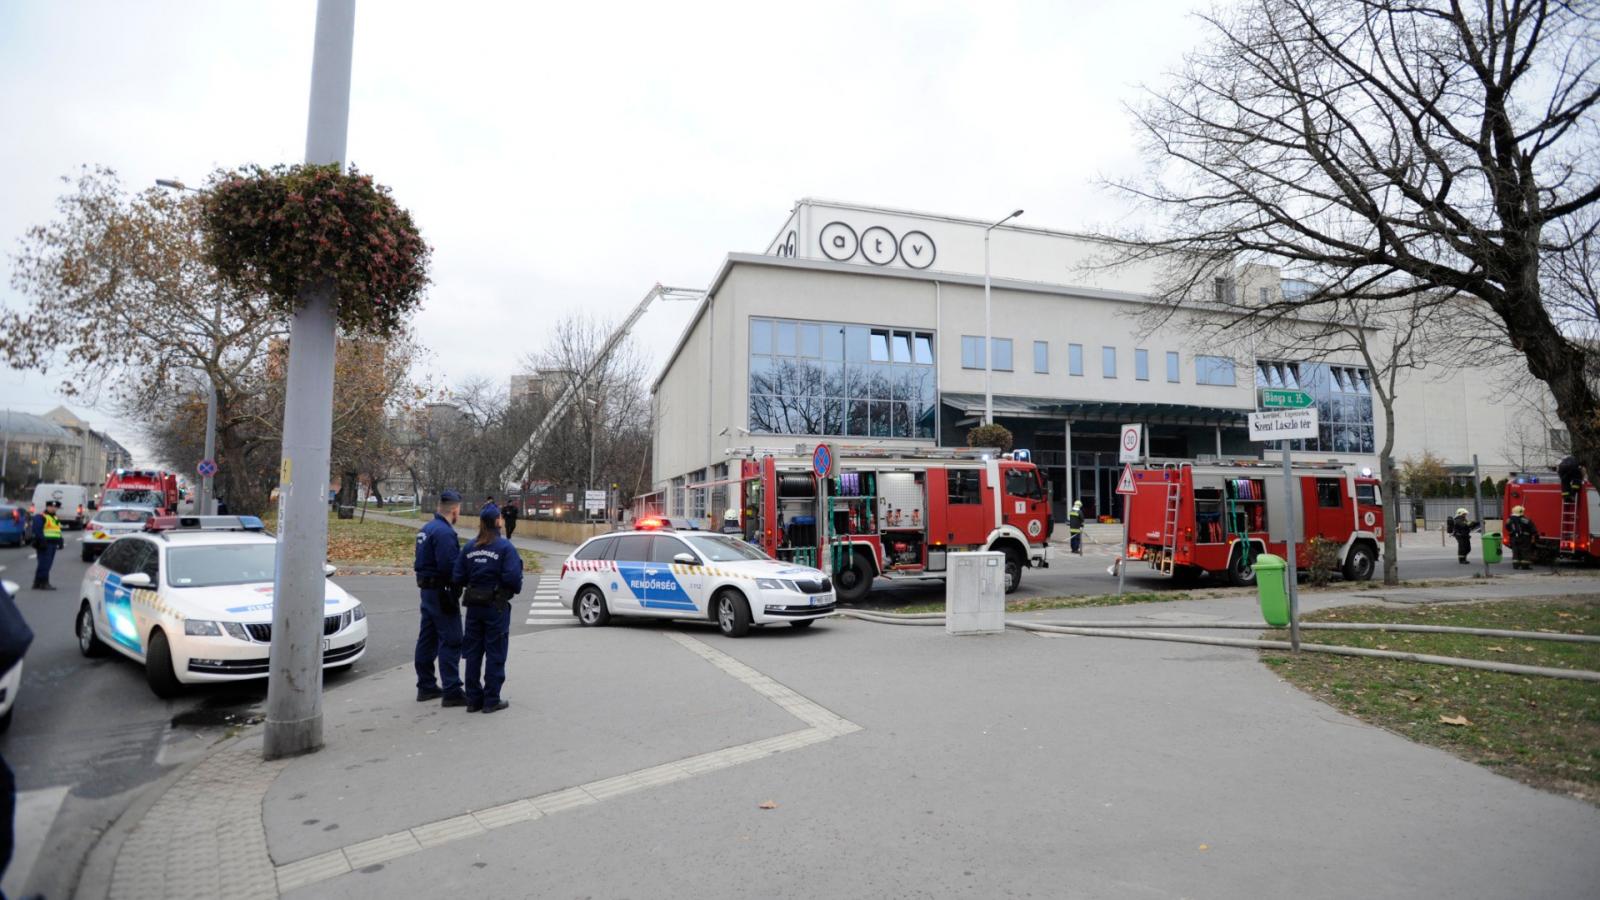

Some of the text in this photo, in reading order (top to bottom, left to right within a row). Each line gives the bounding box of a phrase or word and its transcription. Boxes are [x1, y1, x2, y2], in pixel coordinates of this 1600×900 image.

[1254, 419, 1311, 432] Szent László tér
[1126, 434, 1135, 446] 30
[630, 578, 677, 591] RENDŐRSÉG
